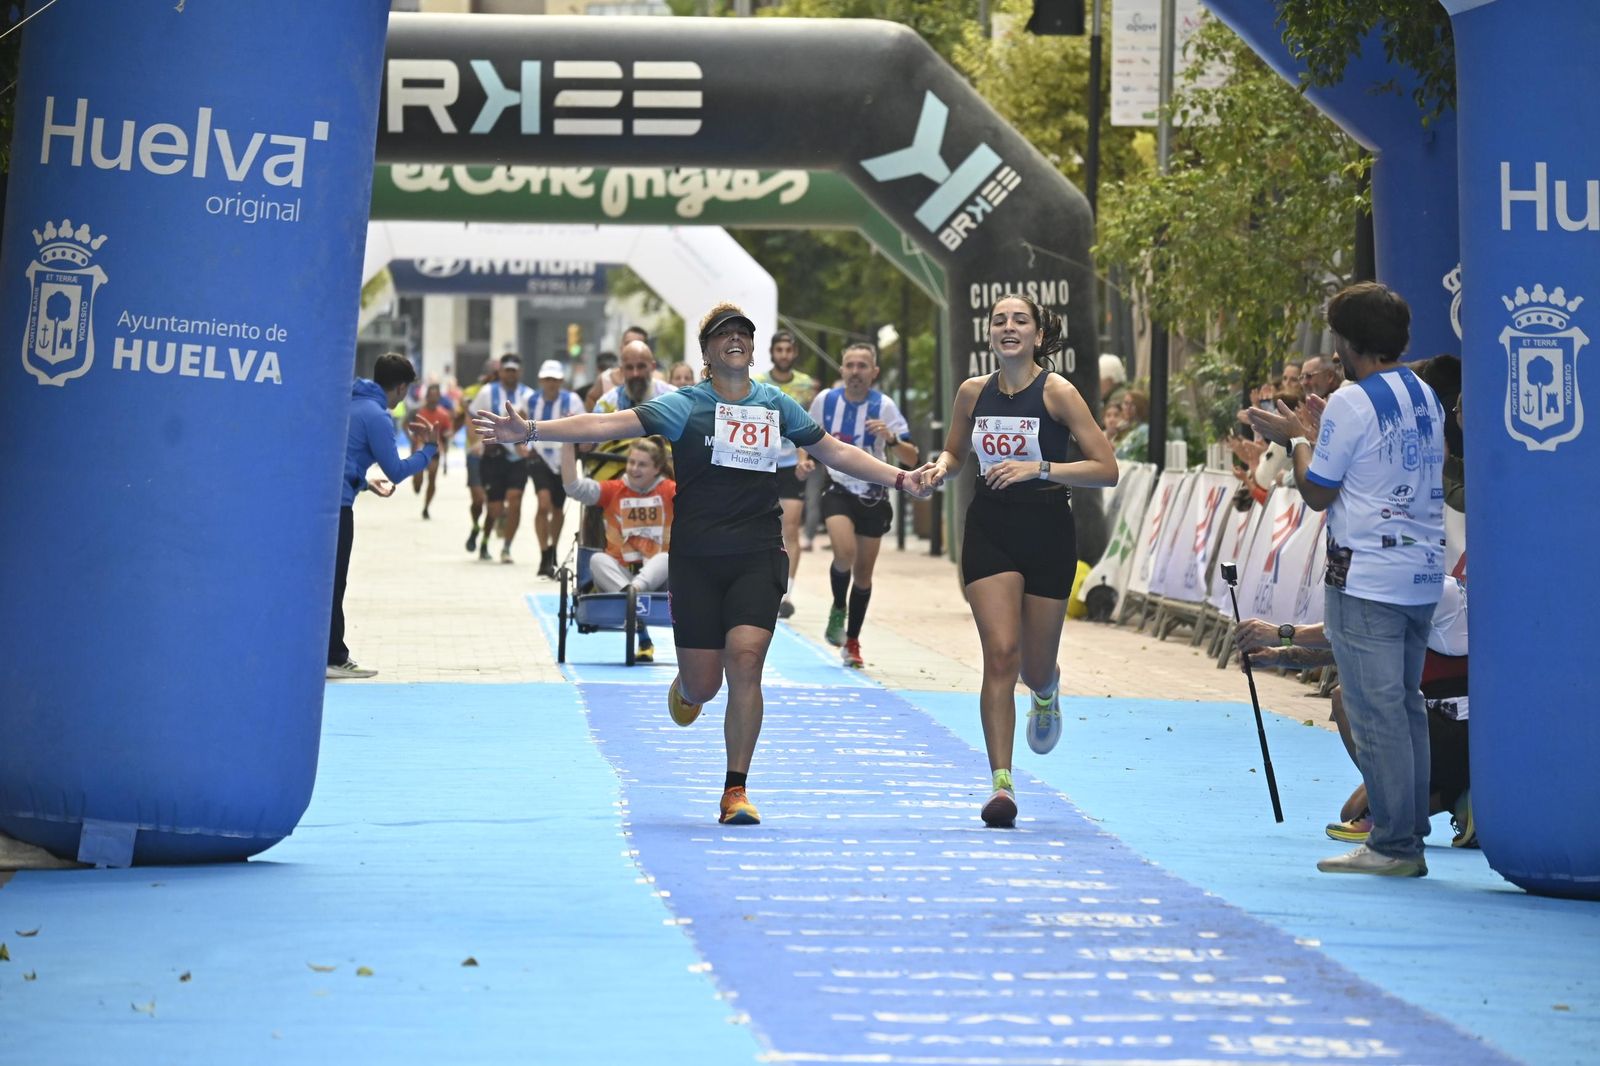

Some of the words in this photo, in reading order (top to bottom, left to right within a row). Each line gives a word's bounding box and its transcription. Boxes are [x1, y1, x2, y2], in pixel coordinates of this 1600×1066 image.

[40, 95, 308, 189] Huelva
[205, 191, 302, 224] original
[46, 273, 54, 281] ET
[969, 279, 1070, 309] CICLISMO
[78, 301, 89, 343] CUSTODIA
[117, 310, 261, 341] Ayuntamiento
[265, 323, 288, 342] de
[1523, 338, 1532, 347] ET
[112, 336, 283, 385] HUELVA
[1511, 382, 1519, 416] PORTUS
[1564, 363, 1572, 406] CUSTODIA
[727, 421, 770, 447] 781
[1020, 419, 1034, 431] 2K
[731, 453, 761, 465] Huelva
[982, 433, 1029, 457] 662
[628, 507, 657, 521] 488
